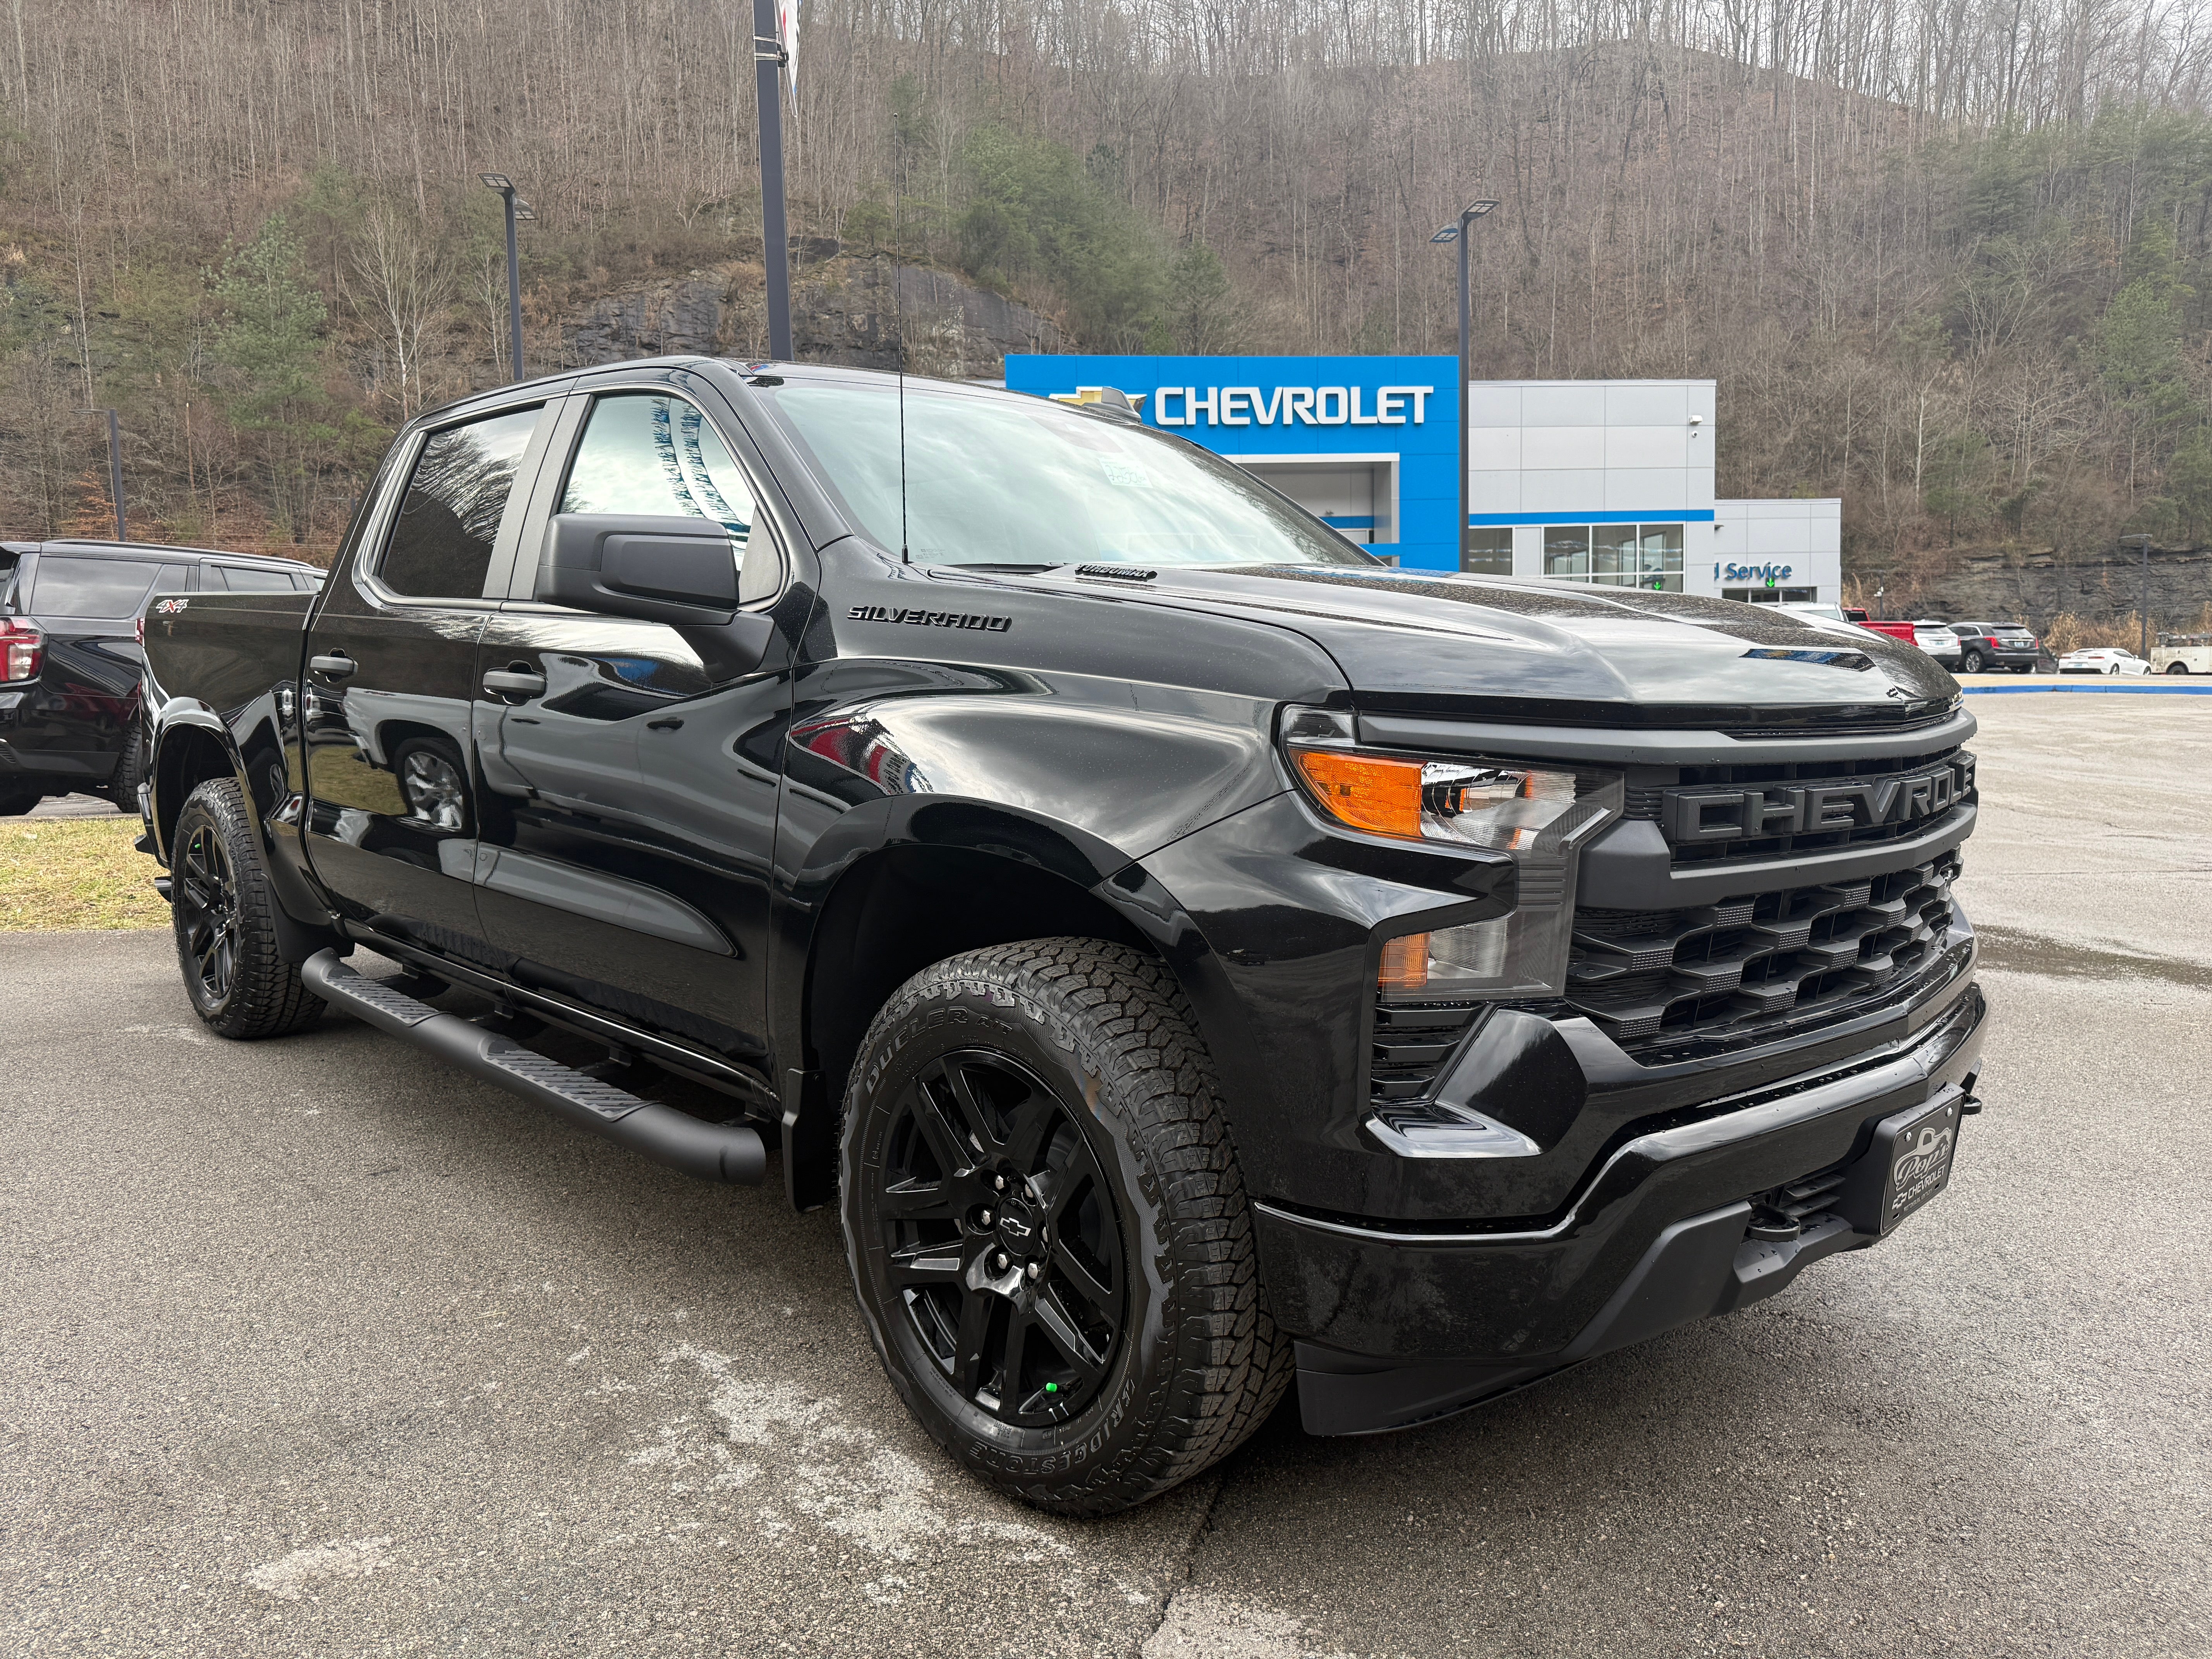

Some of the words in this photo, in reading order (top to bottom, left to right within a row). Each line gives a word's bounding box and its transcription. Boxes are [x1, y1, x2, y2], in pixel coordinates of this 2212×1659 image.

[1155, 386, 1434, 426] CHEVROLET
[1075, 564, 1158, 582] TURBOMAX
[1725, 562, 1792, 579] Service
[847, 606, 1012, 633] SILVERADO
[1663, 750, 1977, 843] CHEVROLE
[850, 1006, 968, 1096] DUELER
[1908, 1164, 1946, 1200] CHEVROLET
[969, 1376, 1135, 1475] BRIDGESTONE
